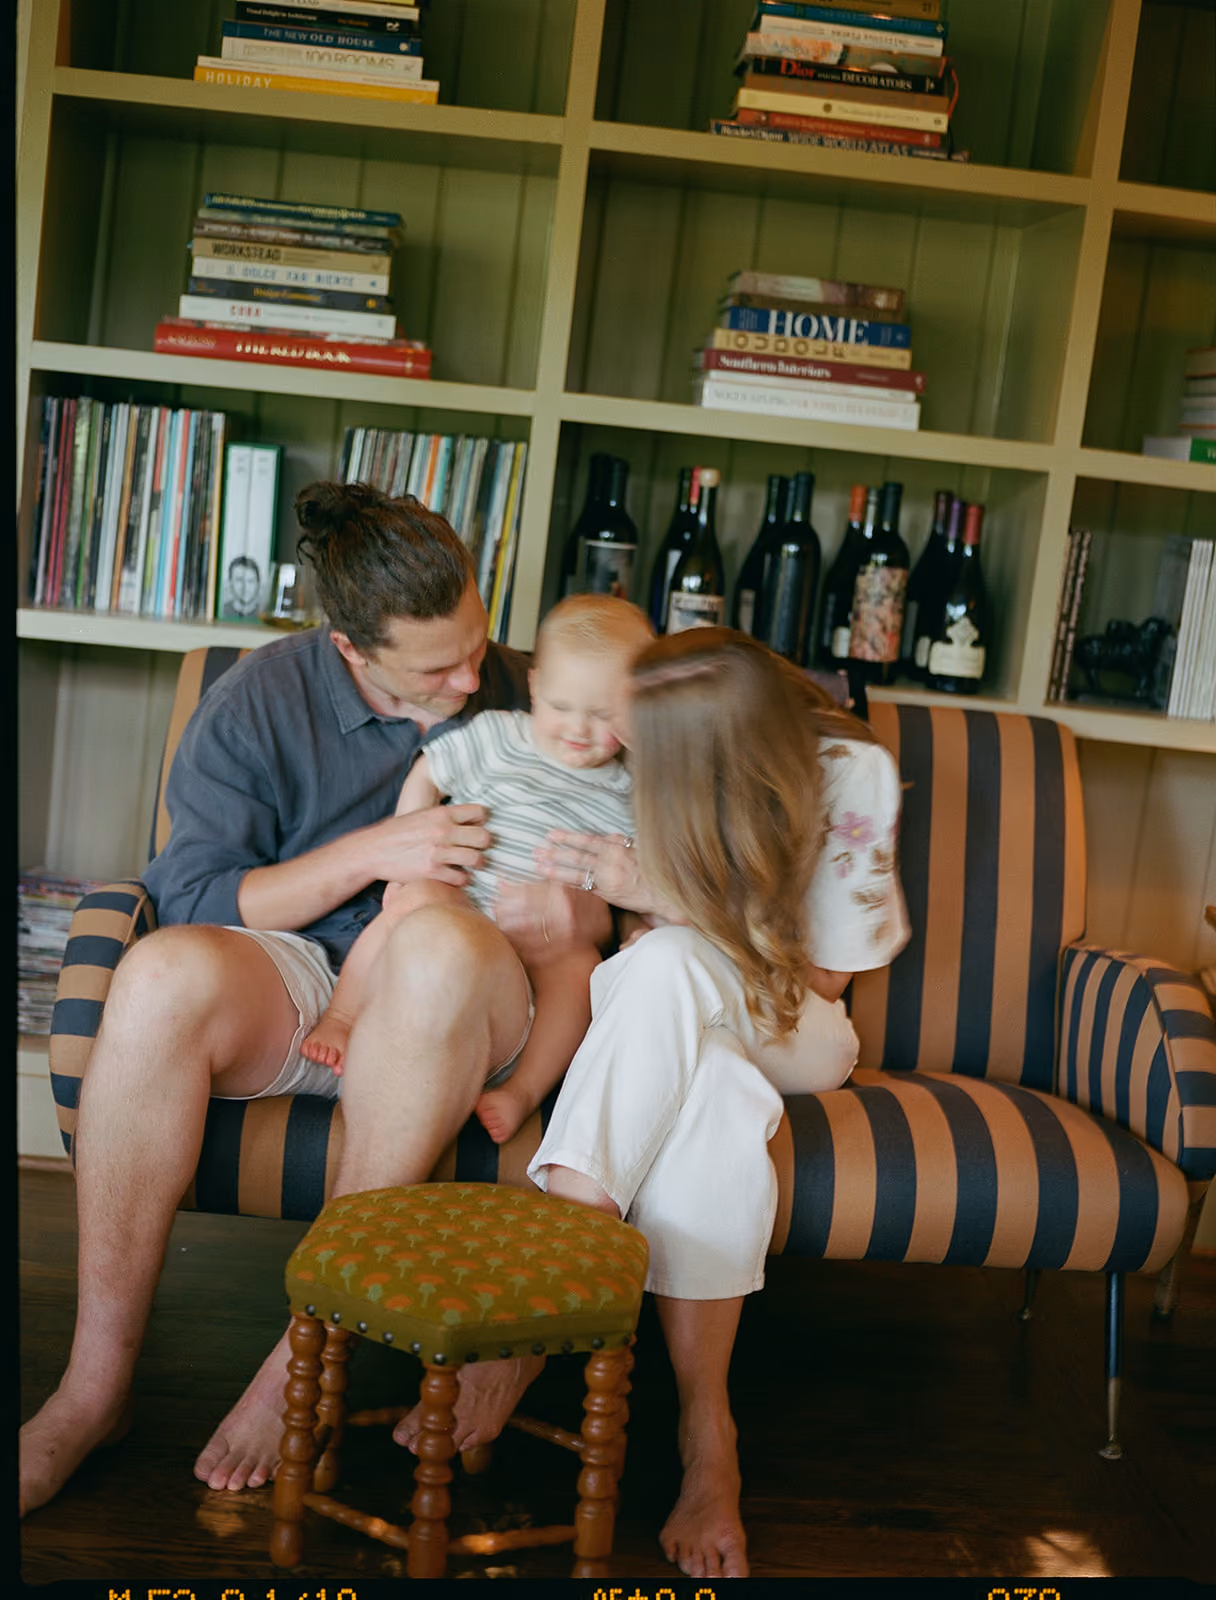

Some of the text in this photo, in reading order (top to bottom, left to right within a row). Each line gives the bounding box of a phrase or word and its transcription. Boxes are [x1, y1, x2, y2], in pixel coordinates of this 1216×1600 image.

[264, 27, 375, 48] THE NEW OLD HOUSE
[780, 59, 816, 80] Dior
[205, 72, 272, 89] HOLIDAY
[768, 309, 871, 346] HOME
[718, 355, 832, 379] Southern Interiors
